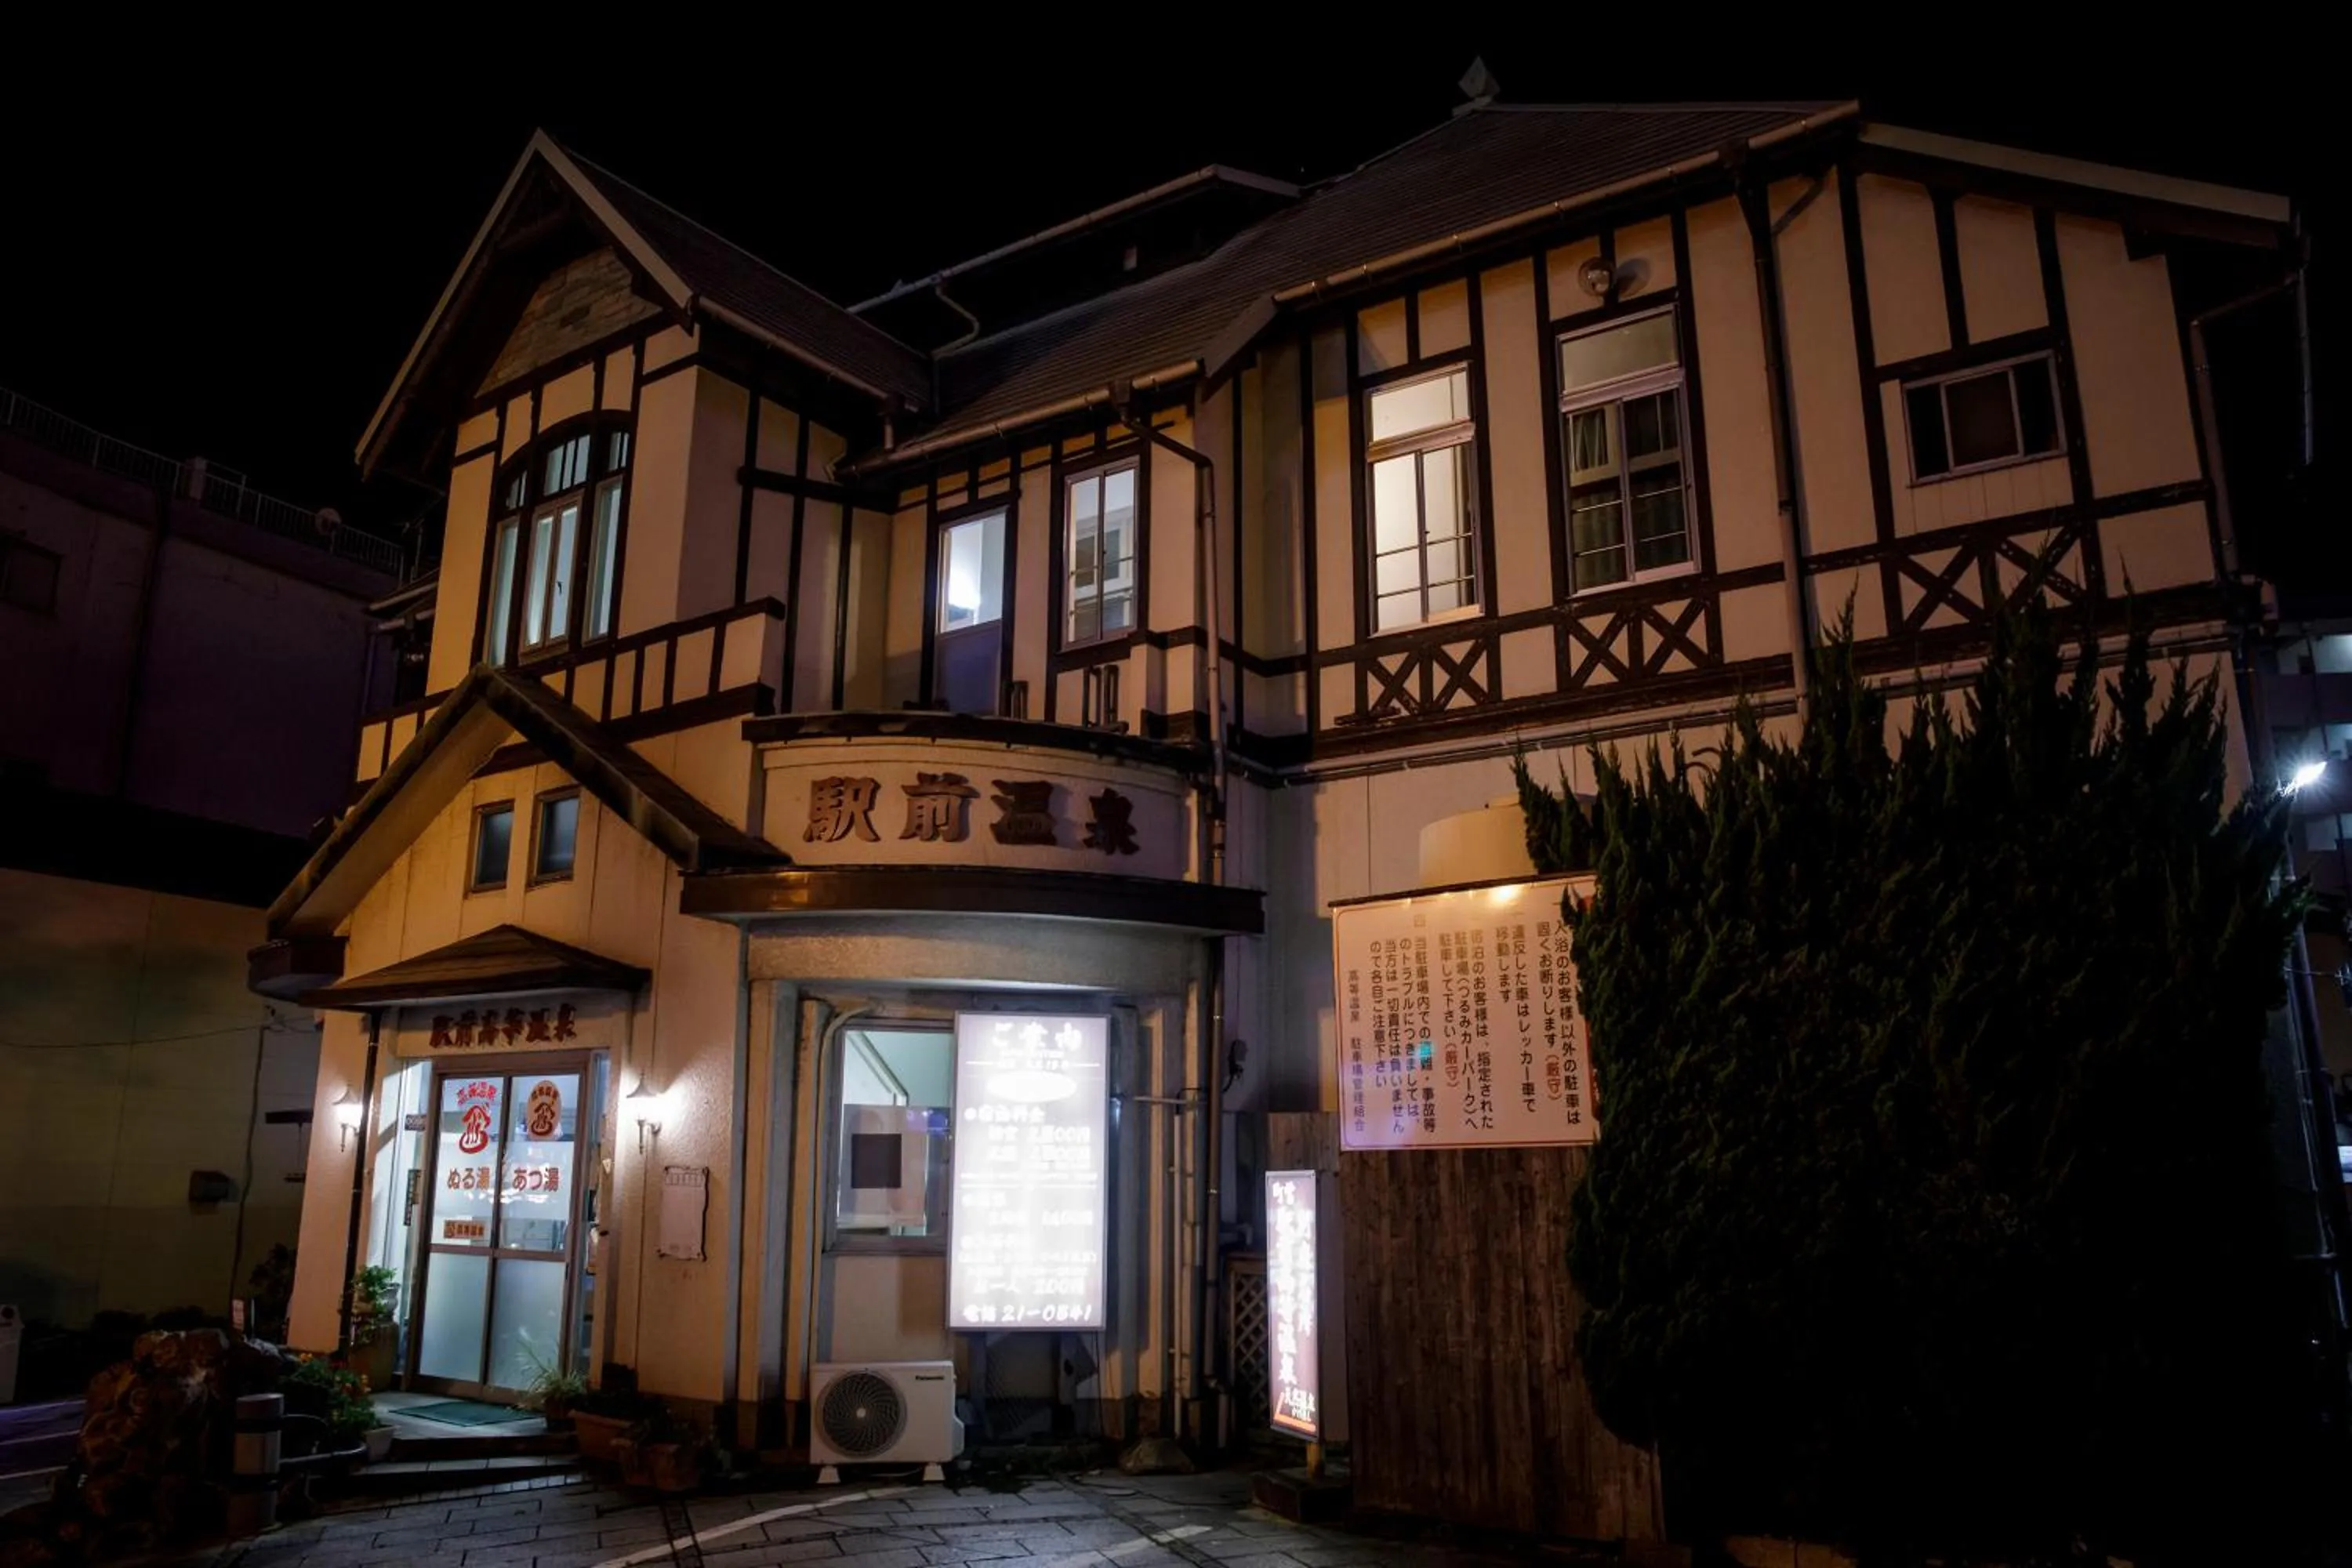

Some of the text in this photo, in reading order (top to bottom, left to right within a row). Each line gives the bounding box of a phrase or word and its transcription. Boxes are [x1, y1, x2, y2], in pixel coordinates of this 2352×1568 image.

[802, 771, 1140, 855] 駅前温泉
[1496, 926, 1512, 1003] 移動します
[1555, 919, 1581, 1125] 入浴のお客様以外の駐車は
[447, 1167, 490, 1189] ぬる湯
[512, 1167, 559, 1192] あつ湯
